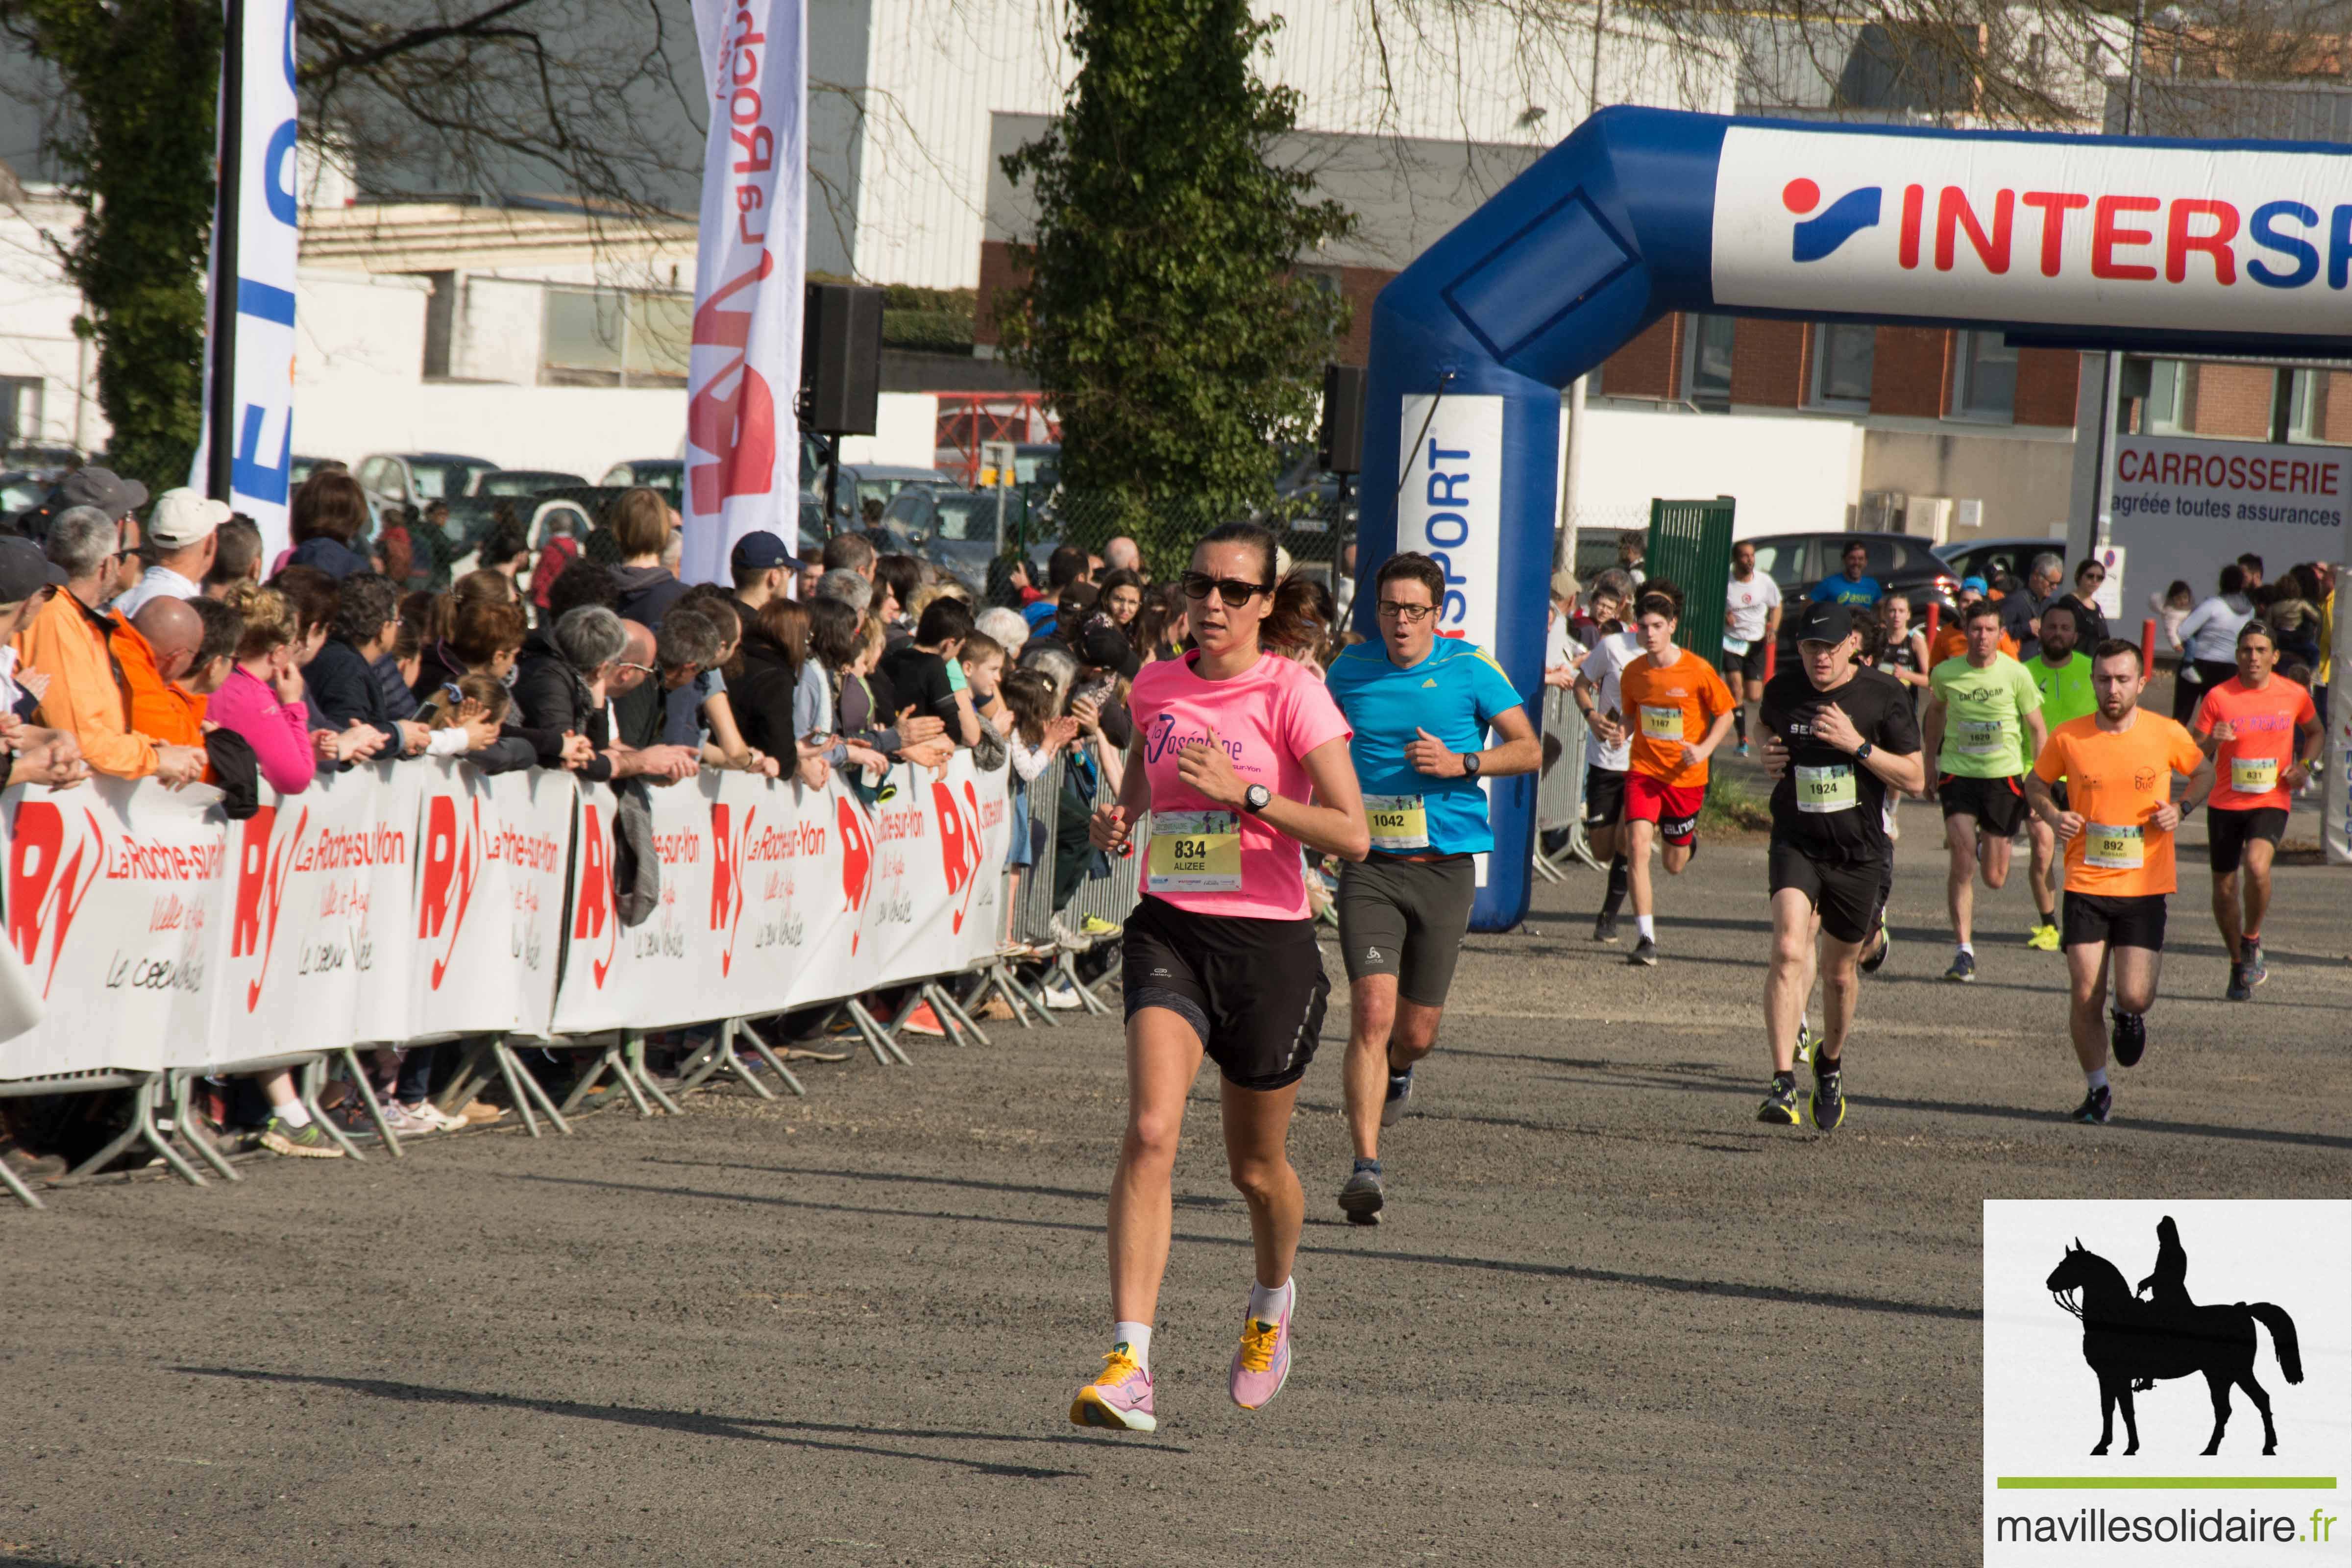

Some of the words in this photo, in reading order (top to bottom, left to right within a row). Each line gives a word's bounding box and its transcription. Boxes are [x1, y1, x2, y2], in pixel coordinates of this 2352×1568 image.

[2117, 449, 2340, 495] CARROSSERIE
[2176, 496, 2231, 519] toutes
[2236, 503, 2341, 527] assurances
[1144, 713, 1243, 764] Joséne
[1810, 783, 1837, 794] 1924
[1373, 814, 1404, 827] 1042
[1175, 840, 1206, 858] 834
[2104, 840, 2124, 851] 892
[1174, 862, 1205, 870] ALIZEE
